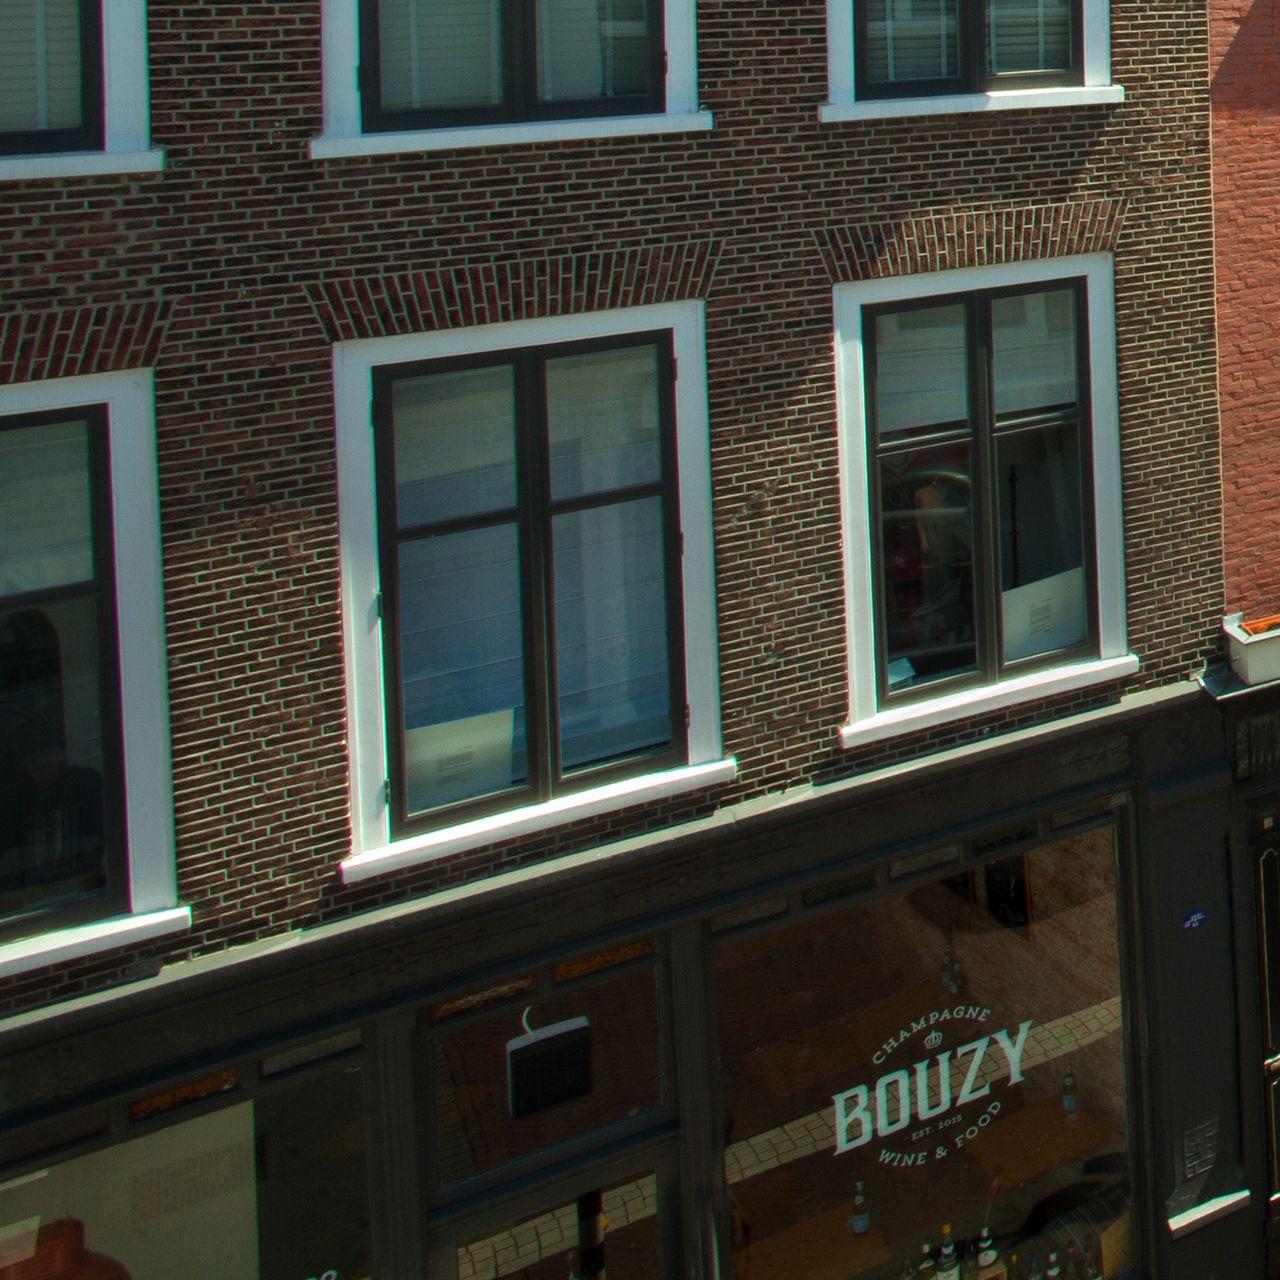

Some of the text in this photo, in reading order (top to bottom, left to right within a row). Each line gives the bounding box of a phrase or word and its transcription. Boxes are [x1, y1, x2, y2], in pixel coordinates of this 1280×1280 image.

[873, 1006, 991, 1064] CHAMPAGNE
[832, 1019, 1034, 1156] BOUZY
[878, 1101, 1001, 1167] WINE & FOOD
[911, 1114, 963, 1141] EST. 2015
